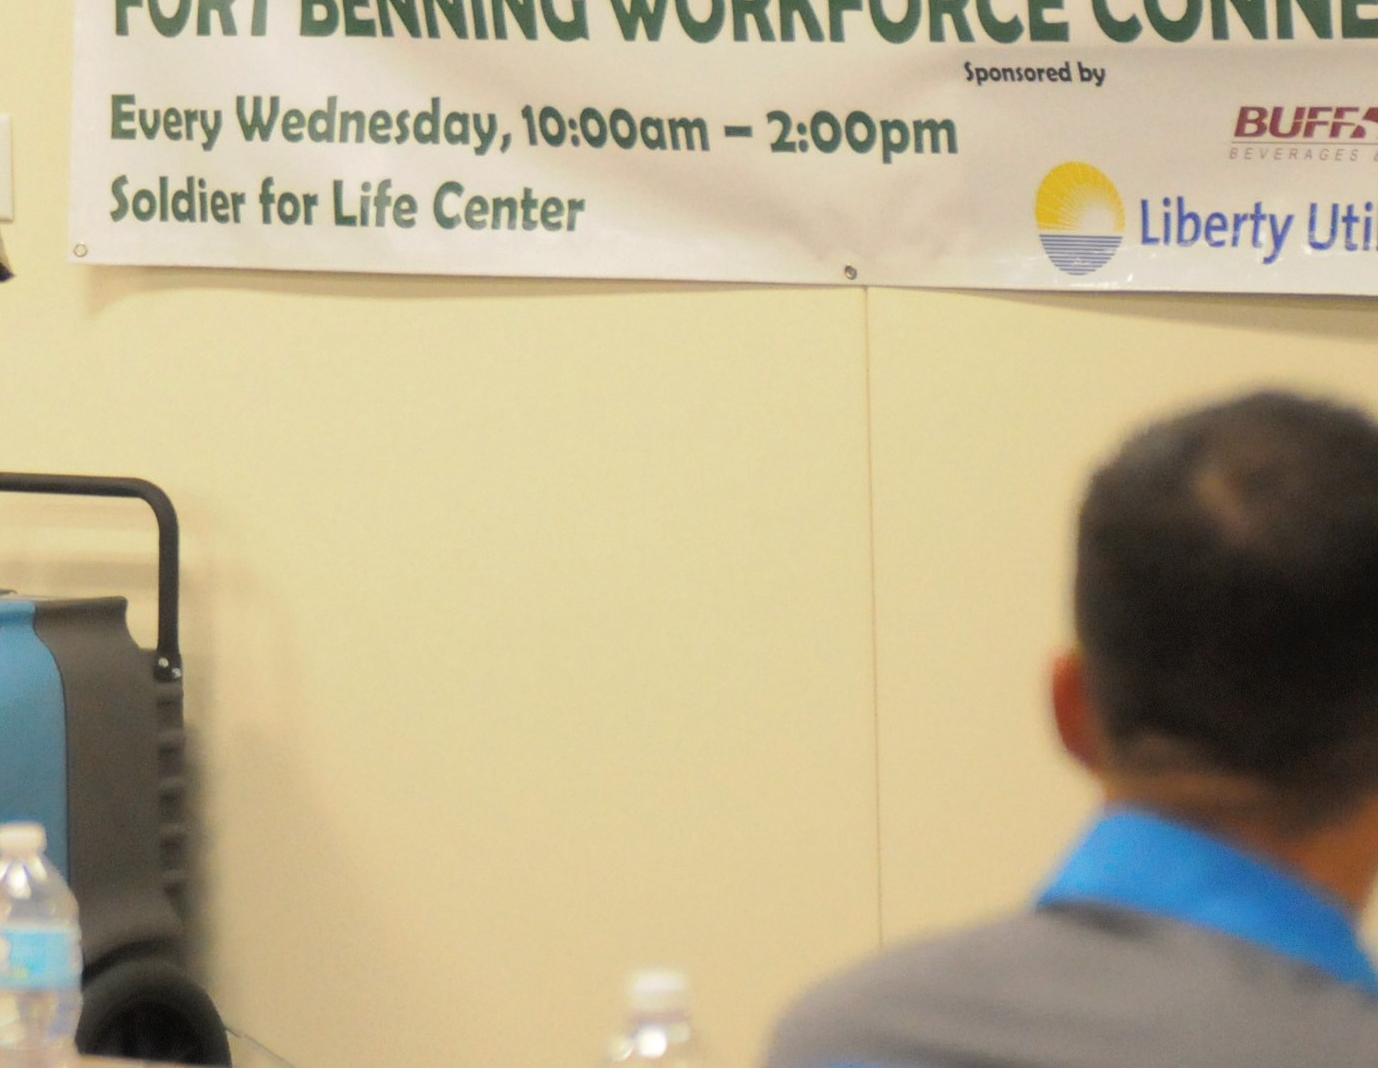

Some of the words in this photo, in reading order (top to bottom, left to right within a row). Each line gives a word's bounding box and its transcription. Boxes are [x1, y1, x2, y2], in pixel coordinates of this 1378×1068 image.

[963, 61, 1073, 86] Sponsored
[1077, 61, 1106, 87] by
[111, 94, 223, 152] Every
[236, 95, 512, 156] Wednesday,
[521, 104, 710, 152] 10:00am
[766, 110, 958, 165] 2:00pm
[1228, 147, 1359, 162] BEVERAGES
[110, 174, 246, 224] Soldier
[258, 176, 319, 226] for
[333, 179, 418, 229] Life
[433, 180, 585, 232] Center
[1140, 195, 1295, 265] Liberty
[1308, 201, 1378, 252] Uti
